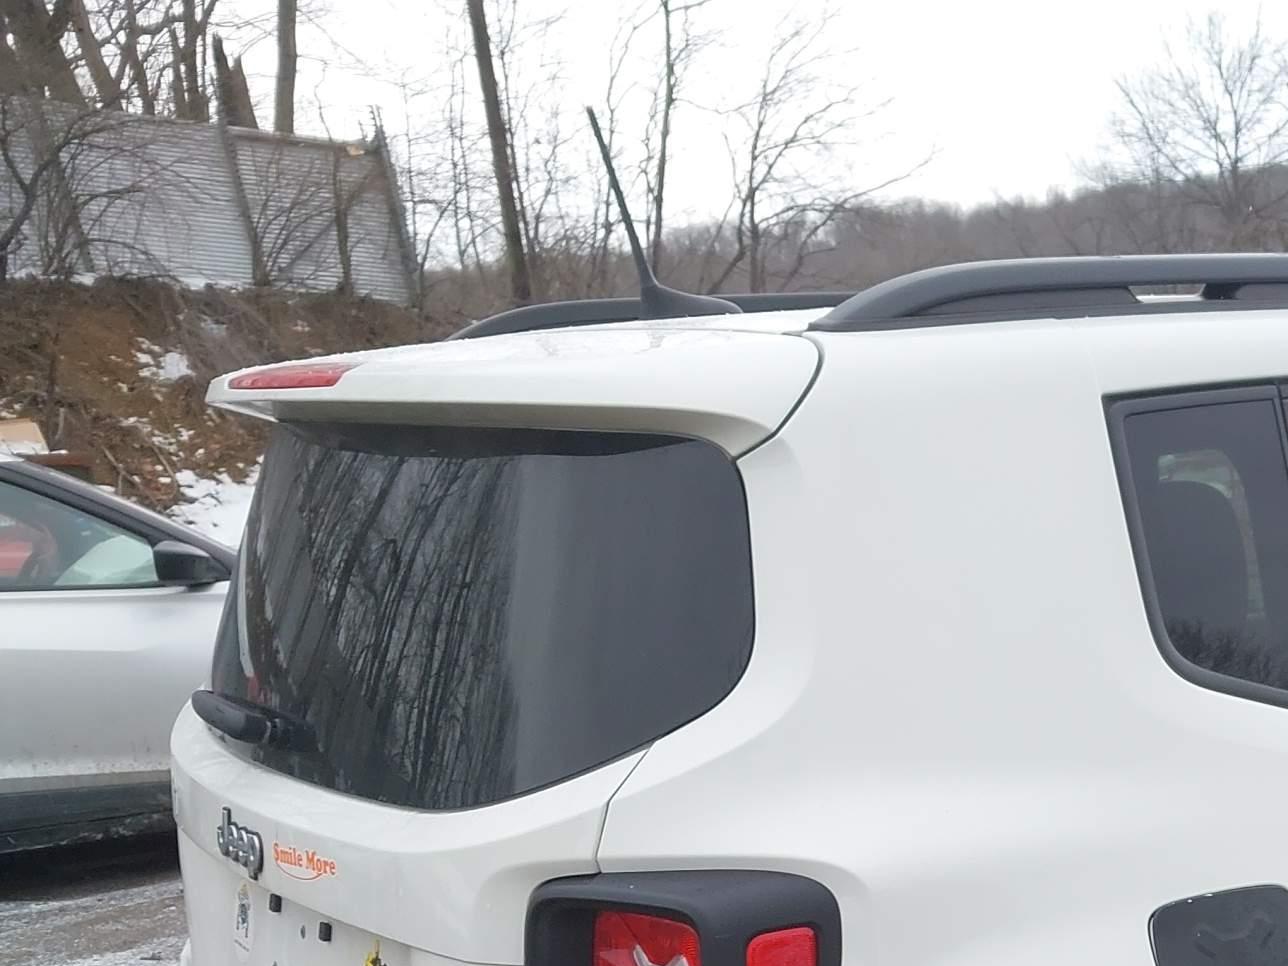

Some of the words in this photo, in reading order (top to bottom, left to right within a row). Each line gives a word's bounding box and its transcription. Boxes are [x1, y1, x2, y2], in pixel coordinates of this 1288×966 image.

[217, 806, 264, 881] Jeep
[273, 843, 304, 869] Smile
[305, 850, 337, 876] More
